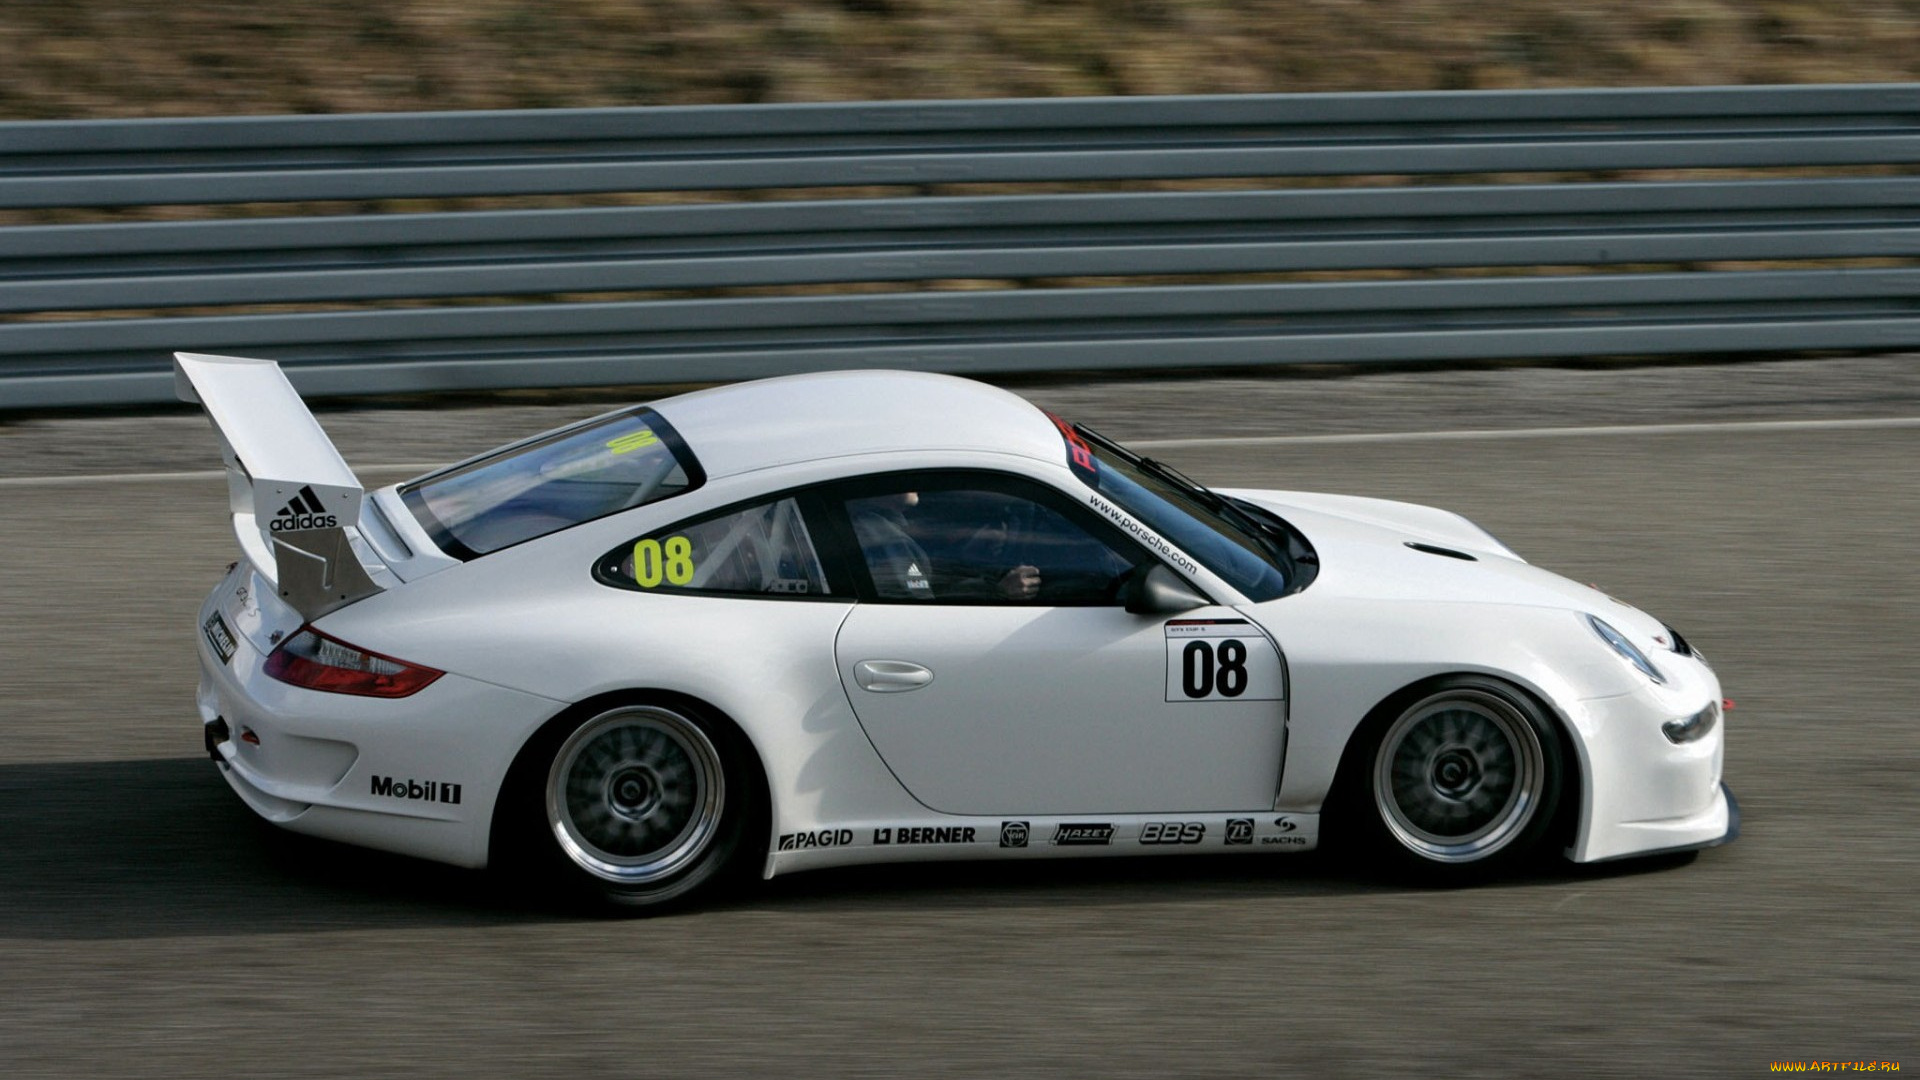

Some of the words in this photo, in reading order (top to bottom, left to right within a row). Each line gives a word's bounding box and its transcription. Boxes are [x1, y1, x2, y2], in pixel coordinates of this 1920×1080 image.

[269, 514, 337, 531] adidas
[1089, 495, 1198, 575] www.porsche.com
[633, 536, 694, 588] 08
[1182, 639, 1248, 699] 08
[371, 775, 437, 802] Mobil
[795, 829, 853, 848] PAGID
[897, 827, 976, 844] BERNER
[1058, 827, 1111, 841] HAZET
[1138, 822, 1206, 845] BBS
[1228, 823, 1249, 841] ZF
[1261, 836, 1306, 845] SACHS
